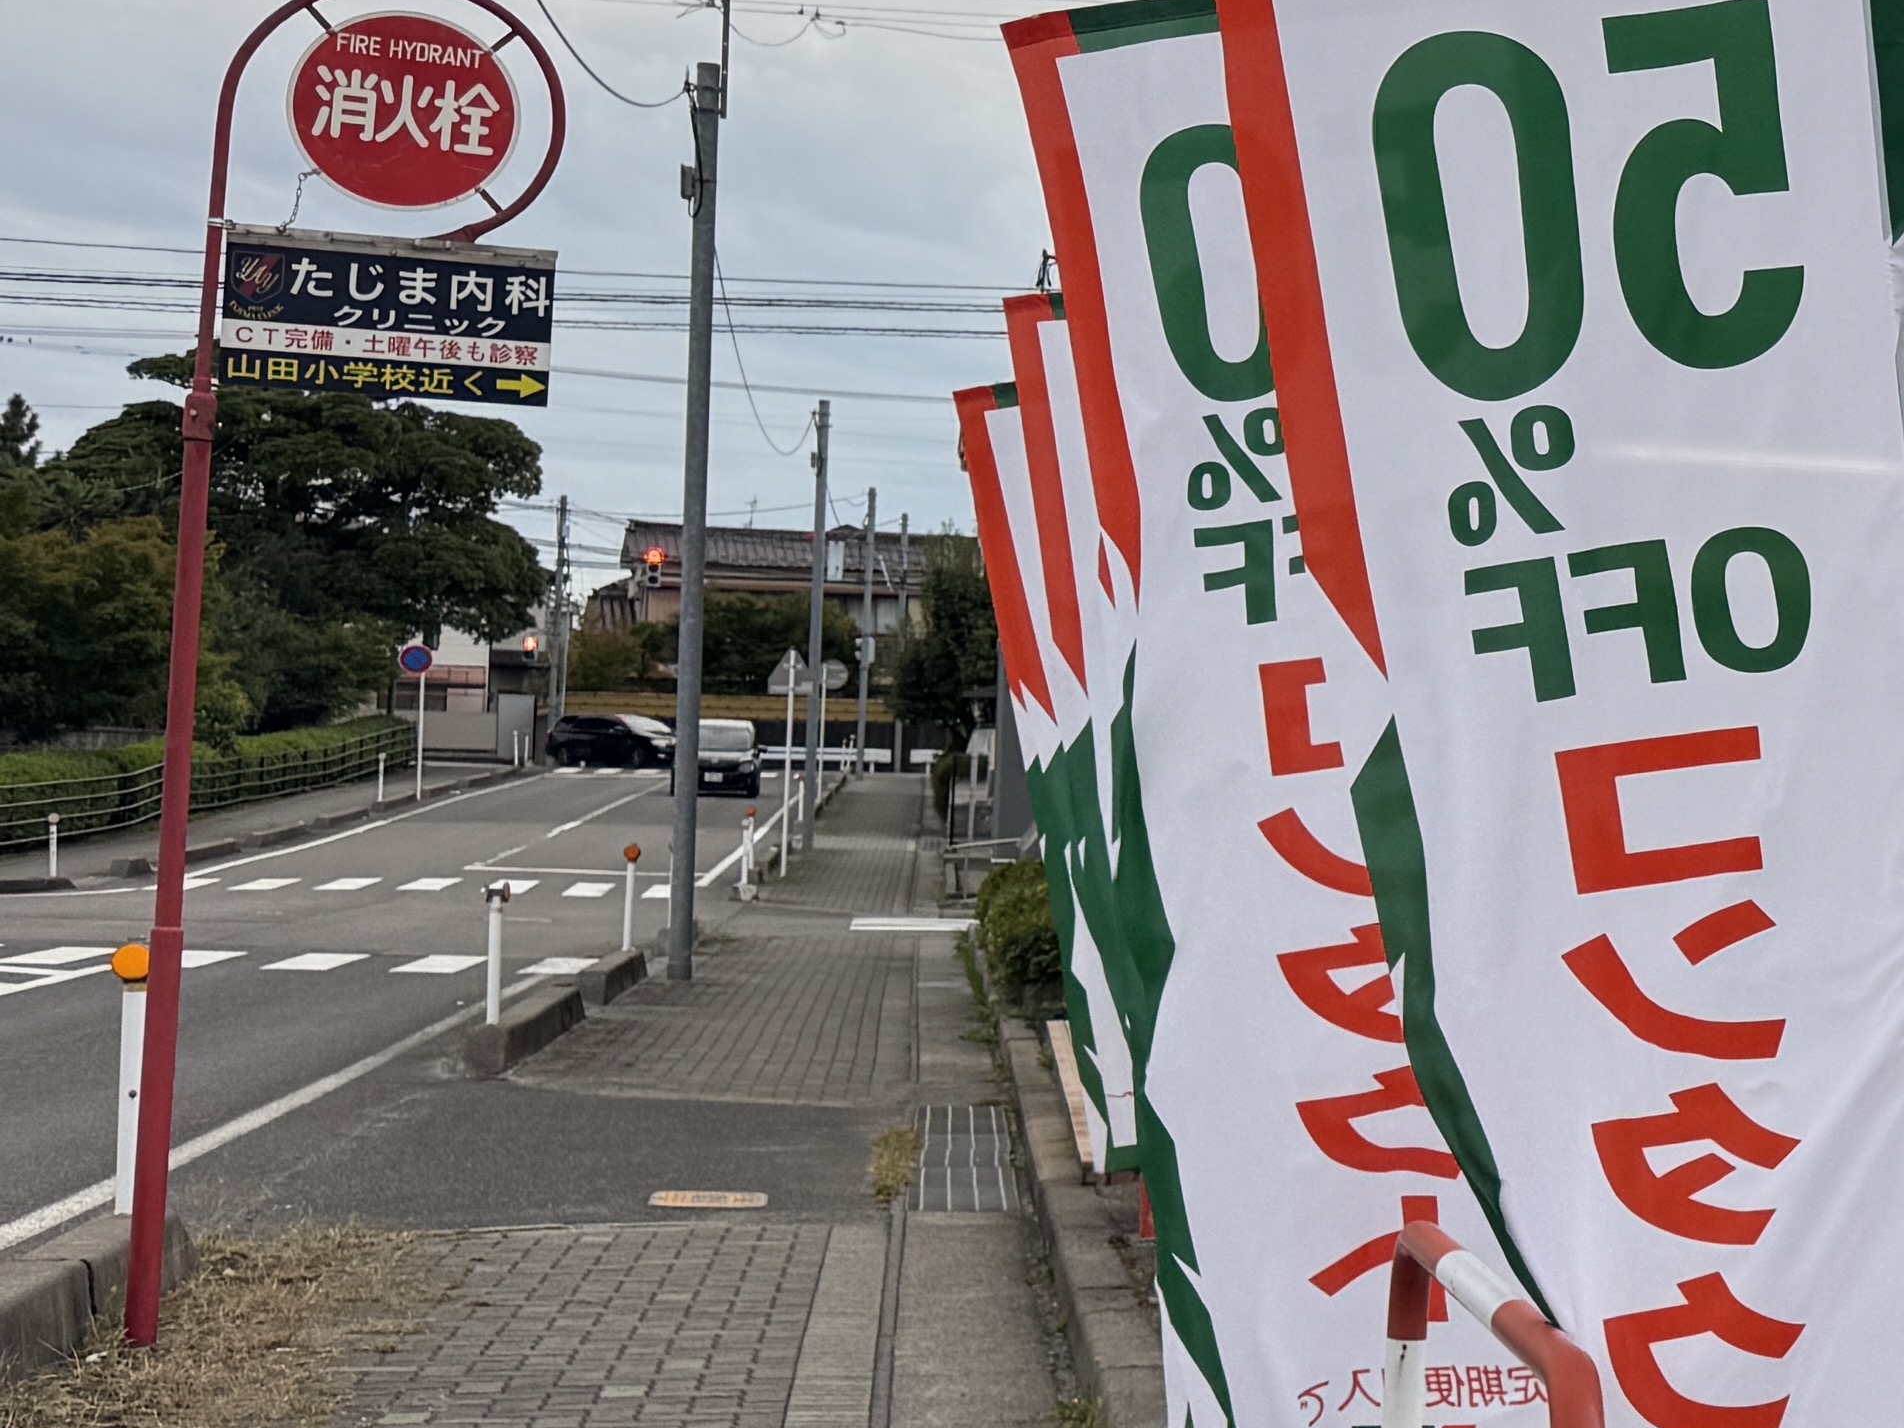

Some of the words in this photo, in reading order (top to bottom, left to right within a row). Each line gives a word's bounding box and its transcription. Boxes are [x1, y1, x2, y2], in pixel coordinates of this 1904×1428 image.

[335, 32, 382, 59] FIRE
[388, 38, 486, 71] HYDRANT
[310, 64, 501, 158] 消火栓
[290, 257, 550, 318] たじま内科
[333, 305, 507, 338] クリニック
[235, 326, 539, 366] CT完備・土曜午後も診察
[227, 353, 484, 396] 山田小学校近く
